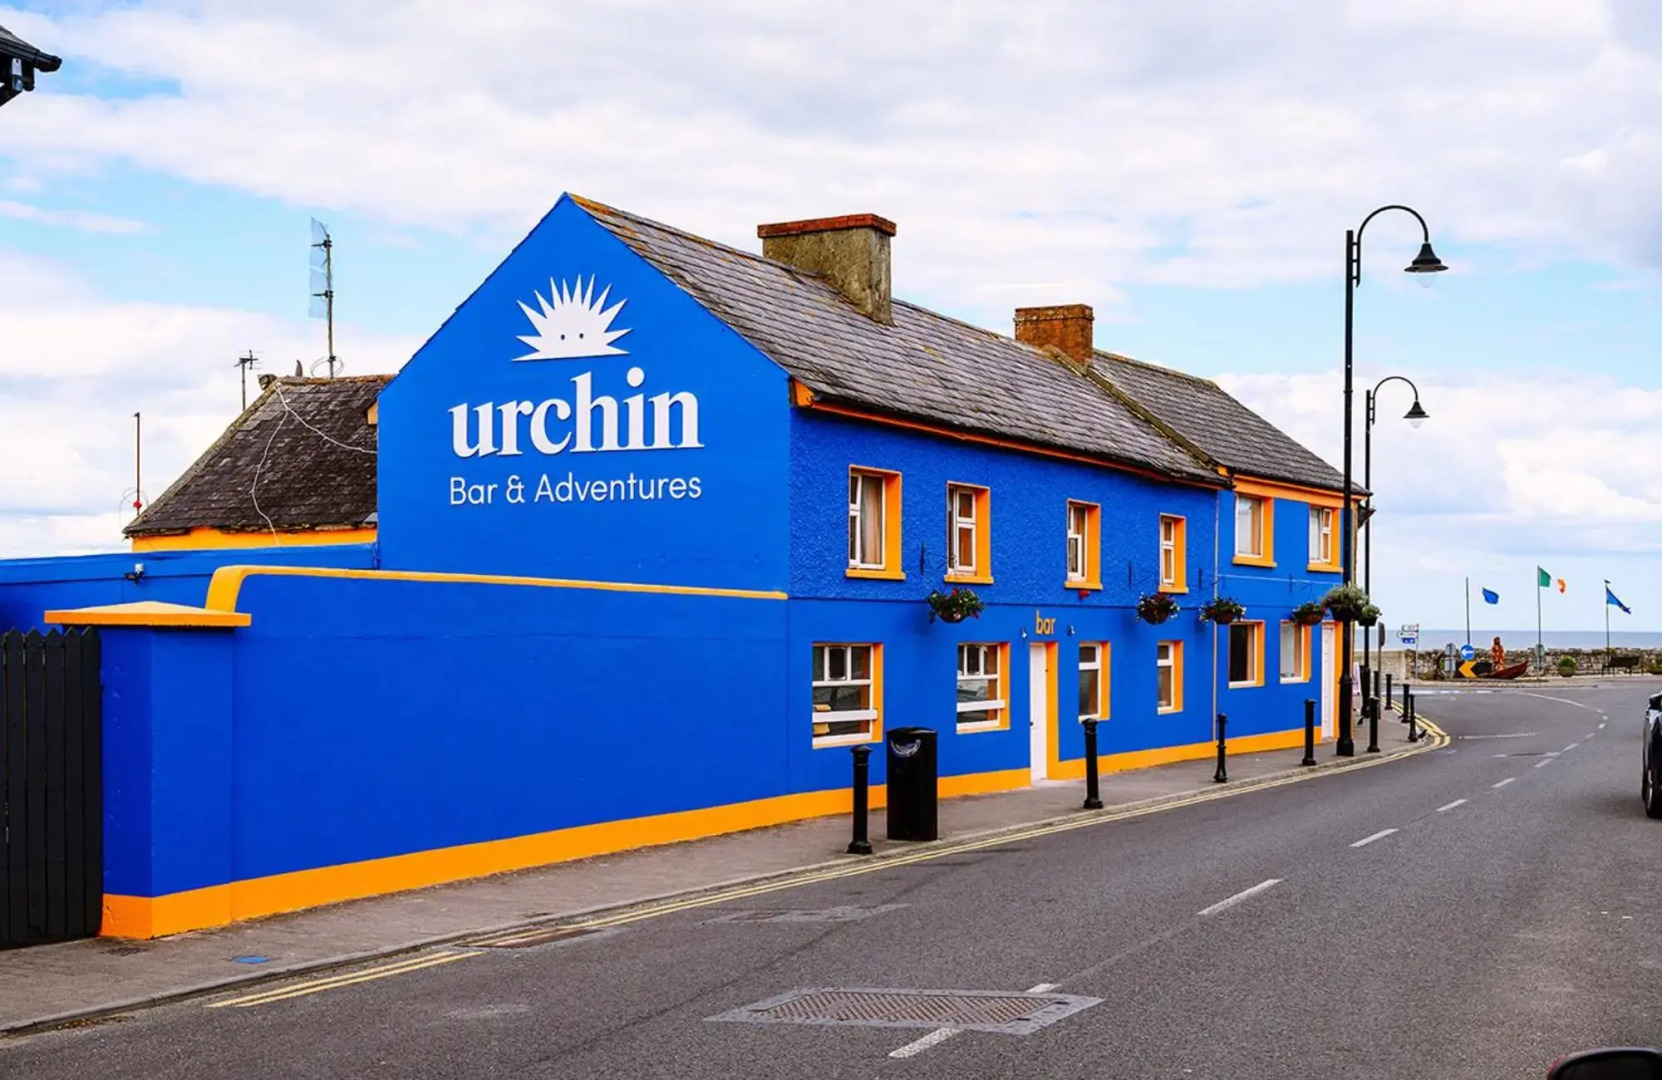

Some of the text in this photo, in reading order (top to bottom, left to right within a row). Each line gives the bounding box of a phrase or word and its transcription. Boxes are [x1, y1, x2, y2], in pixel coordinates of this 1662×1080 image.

[448, 366, 704, 458] urchin
[450, 471, 702, 505] Bar & Adventures
[1035, 610, 1056, 635] bar
